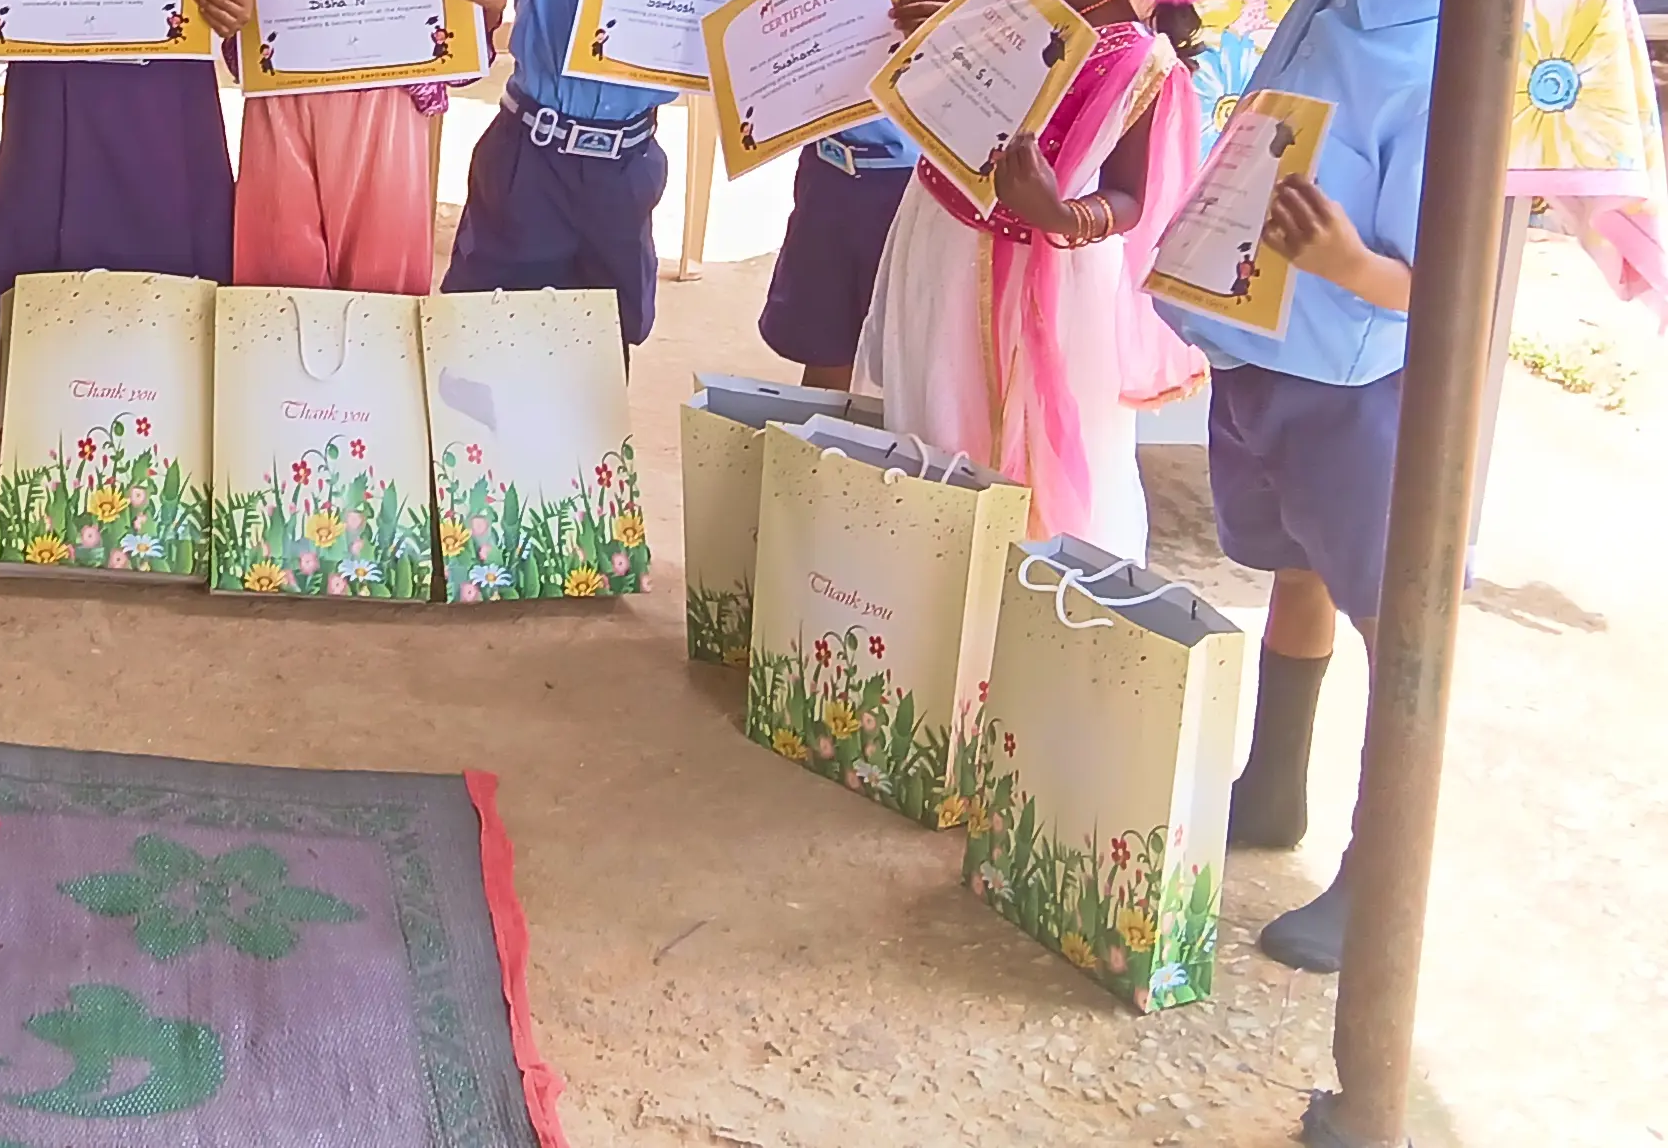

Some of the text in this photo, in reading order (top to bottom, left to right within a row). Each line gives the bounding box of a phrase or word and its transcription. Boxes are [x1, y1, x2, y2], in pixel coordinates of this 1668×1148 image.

[69, 380, 157, 401] Thank you
[281, 400, 370, 423] Thank you
[808, 571, 893, 620] Thank you
